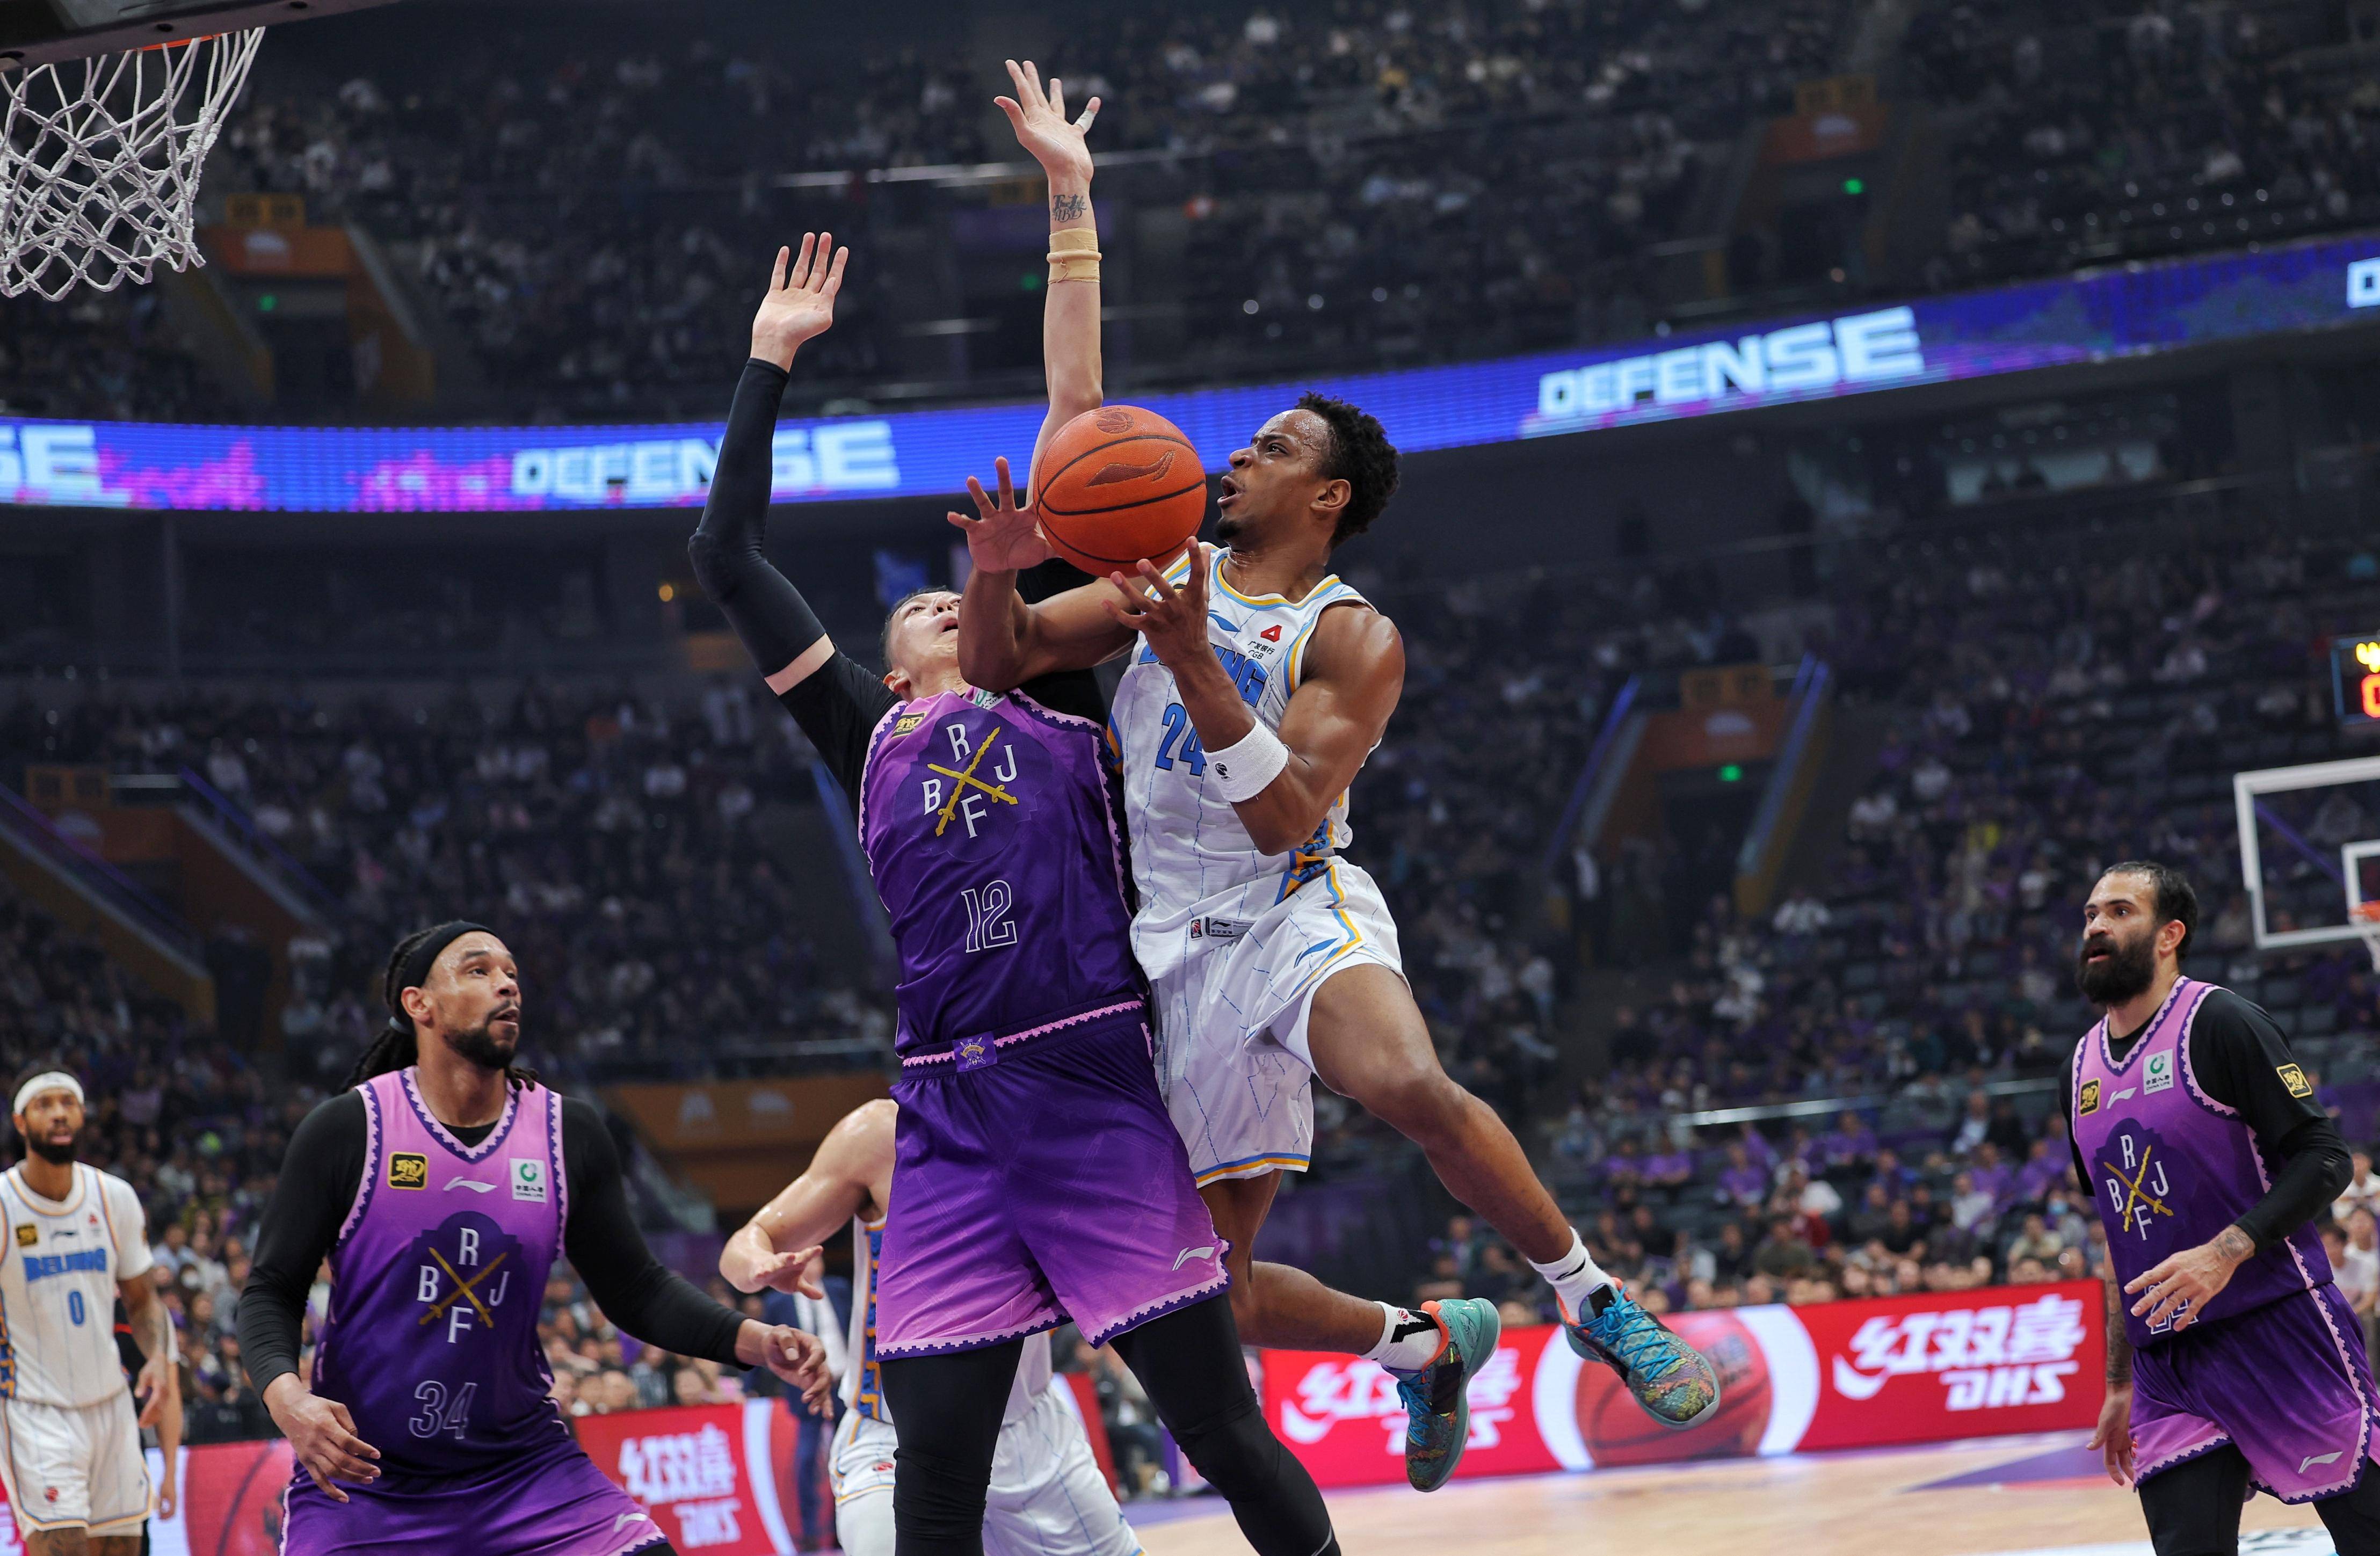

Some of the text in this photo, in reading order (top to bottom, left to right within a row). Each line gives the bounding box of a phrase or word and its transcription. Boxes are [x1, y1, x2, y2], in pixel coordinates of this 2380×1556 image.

[1537, 305, 1924, 418] DEFENSE
[1247, 641, 1275, 655] 广发银行
[1155, 702, 1207, 777] 24
[961, 879, 1018, 954] 12
[23, 1248, 106, 1282] BEIJING
[68, 1290, 85, 1327] 0
[1832, 1293, 2087, 1400] 红双喜
[408, 1379, 478, 1441] 34
[1939, 1359, 2080, 1412] DHS
